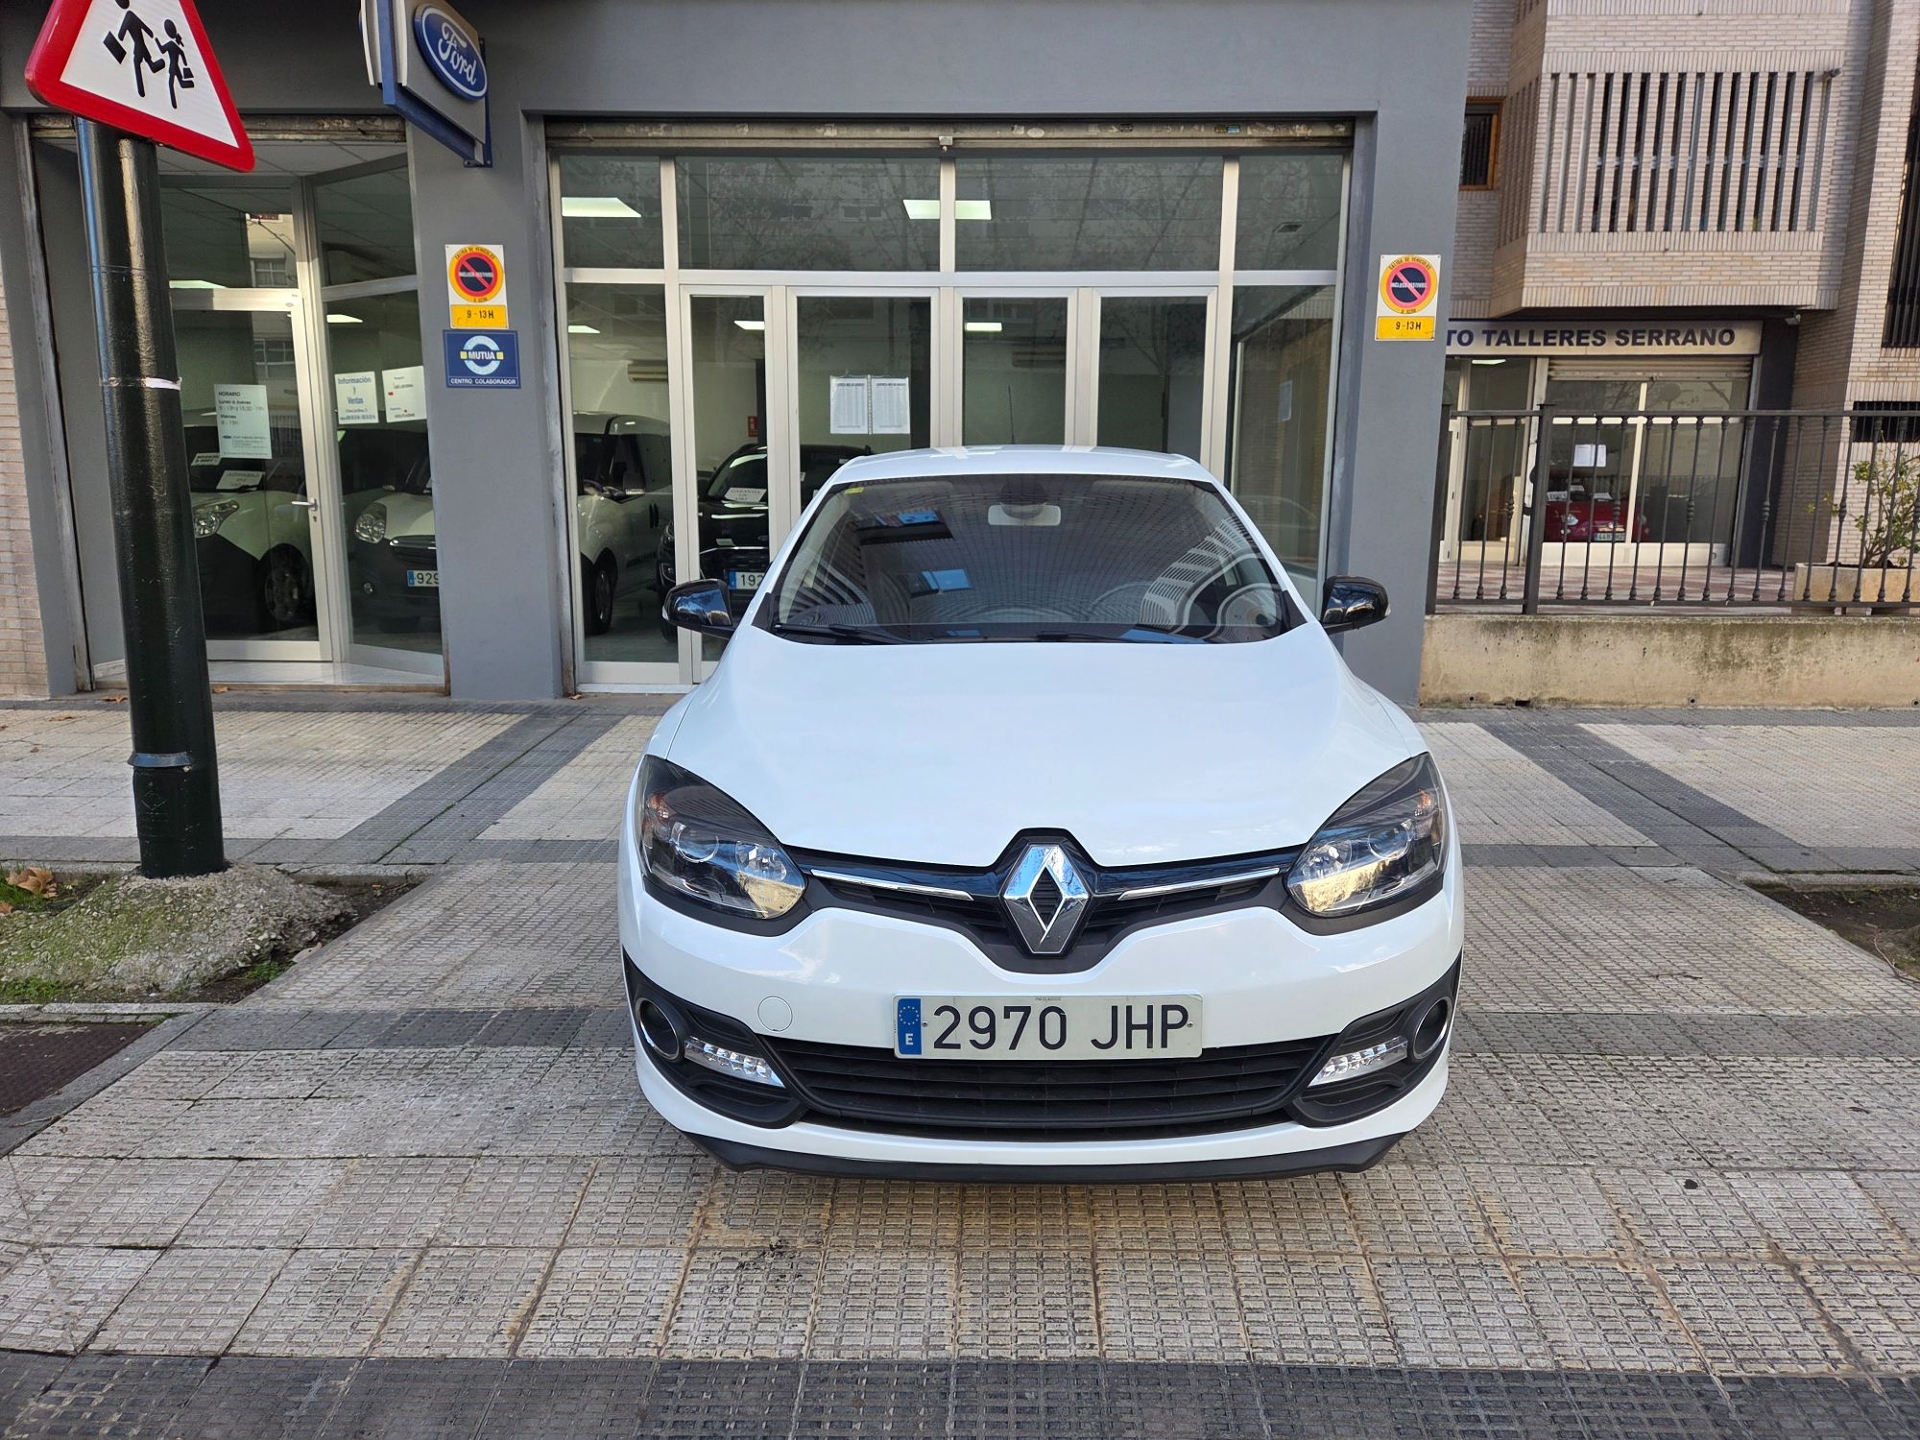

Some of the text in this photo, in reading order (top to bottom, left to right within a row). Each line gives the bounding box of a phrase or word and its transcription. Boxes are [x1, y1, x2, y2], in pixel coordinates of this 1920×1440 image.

[438, 22, 477, 86] Ford
[1482, 329, 1606, 347] TALLERES
[1614, 328, 1736, 347] SERRANO
[468, 351, 496, 360] MUTUA
[905, 1004, 1190, 1050] E 2970 JHP
